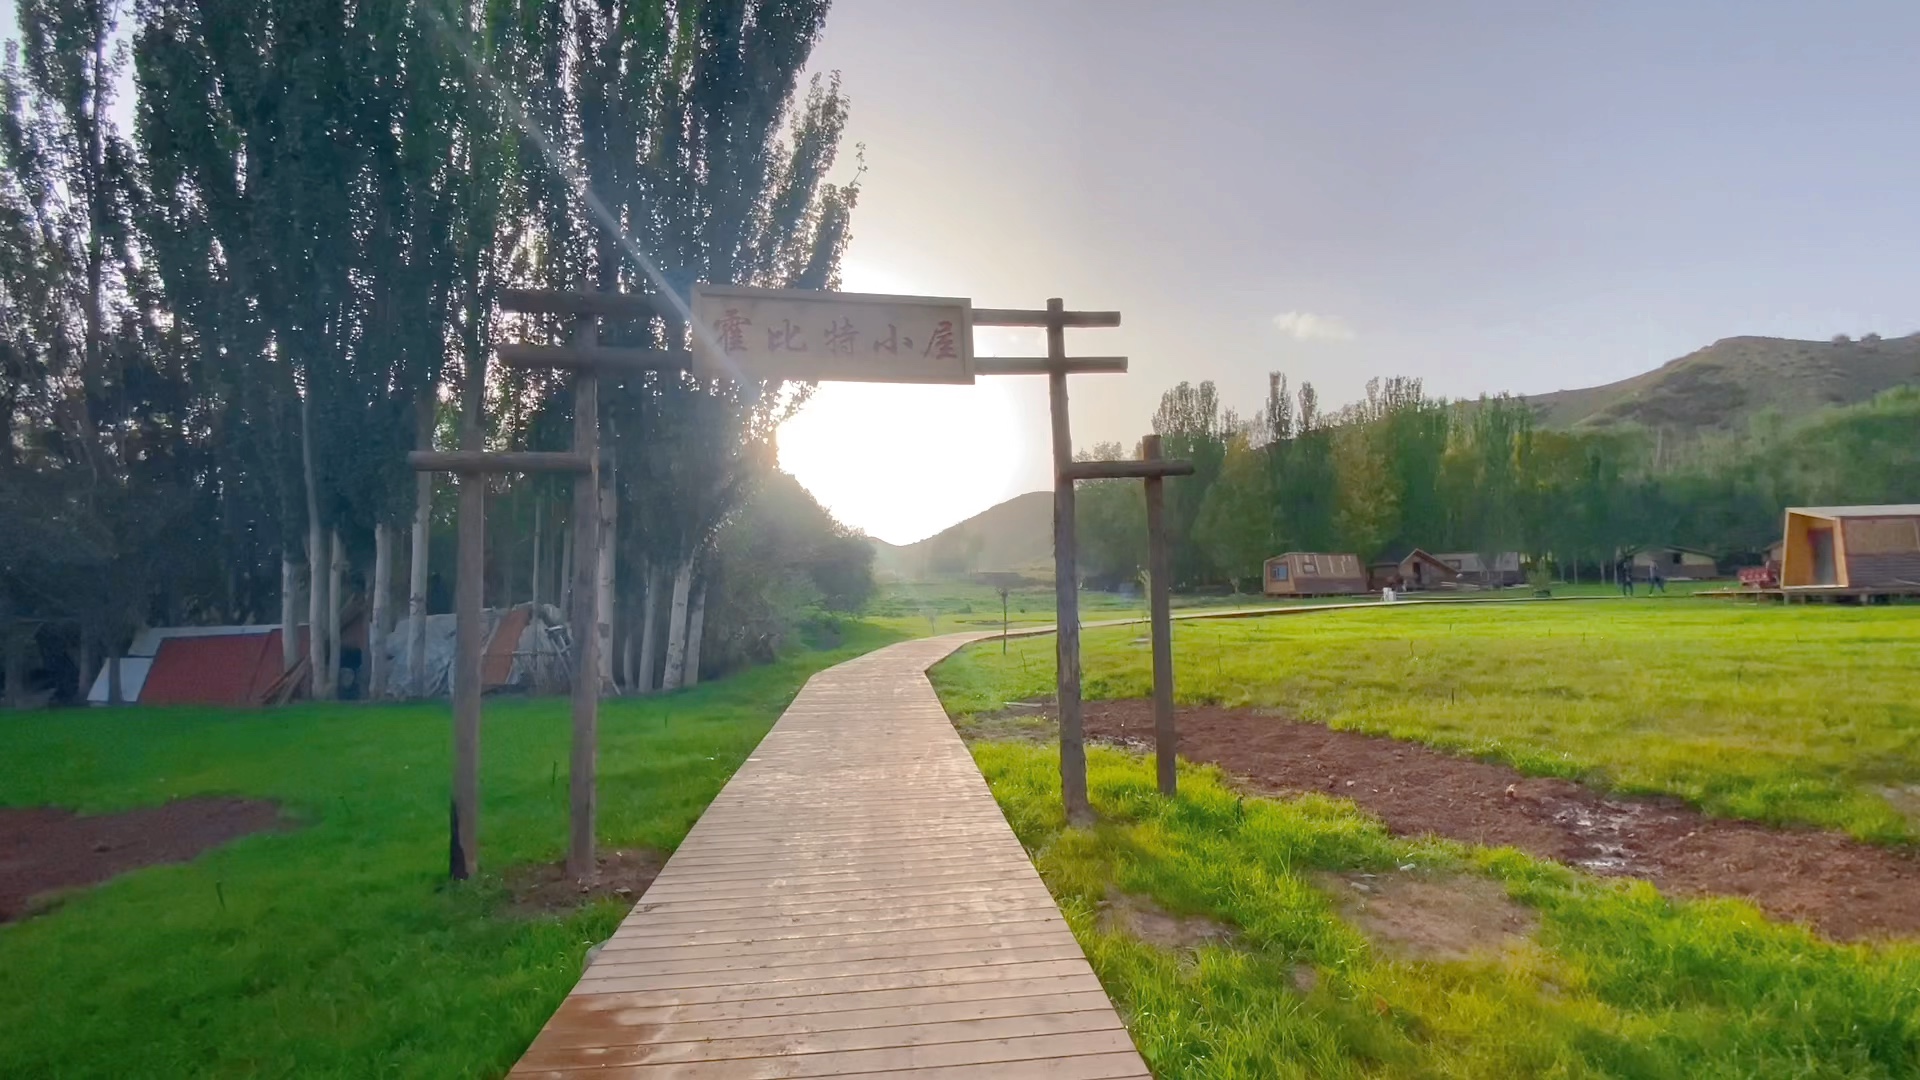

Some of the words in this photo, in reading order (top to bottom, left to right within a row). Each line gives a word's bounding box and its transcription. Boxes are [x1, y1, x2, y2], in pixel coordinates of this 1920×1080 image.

[713, 308, 958, 360] 霍比特小屋
